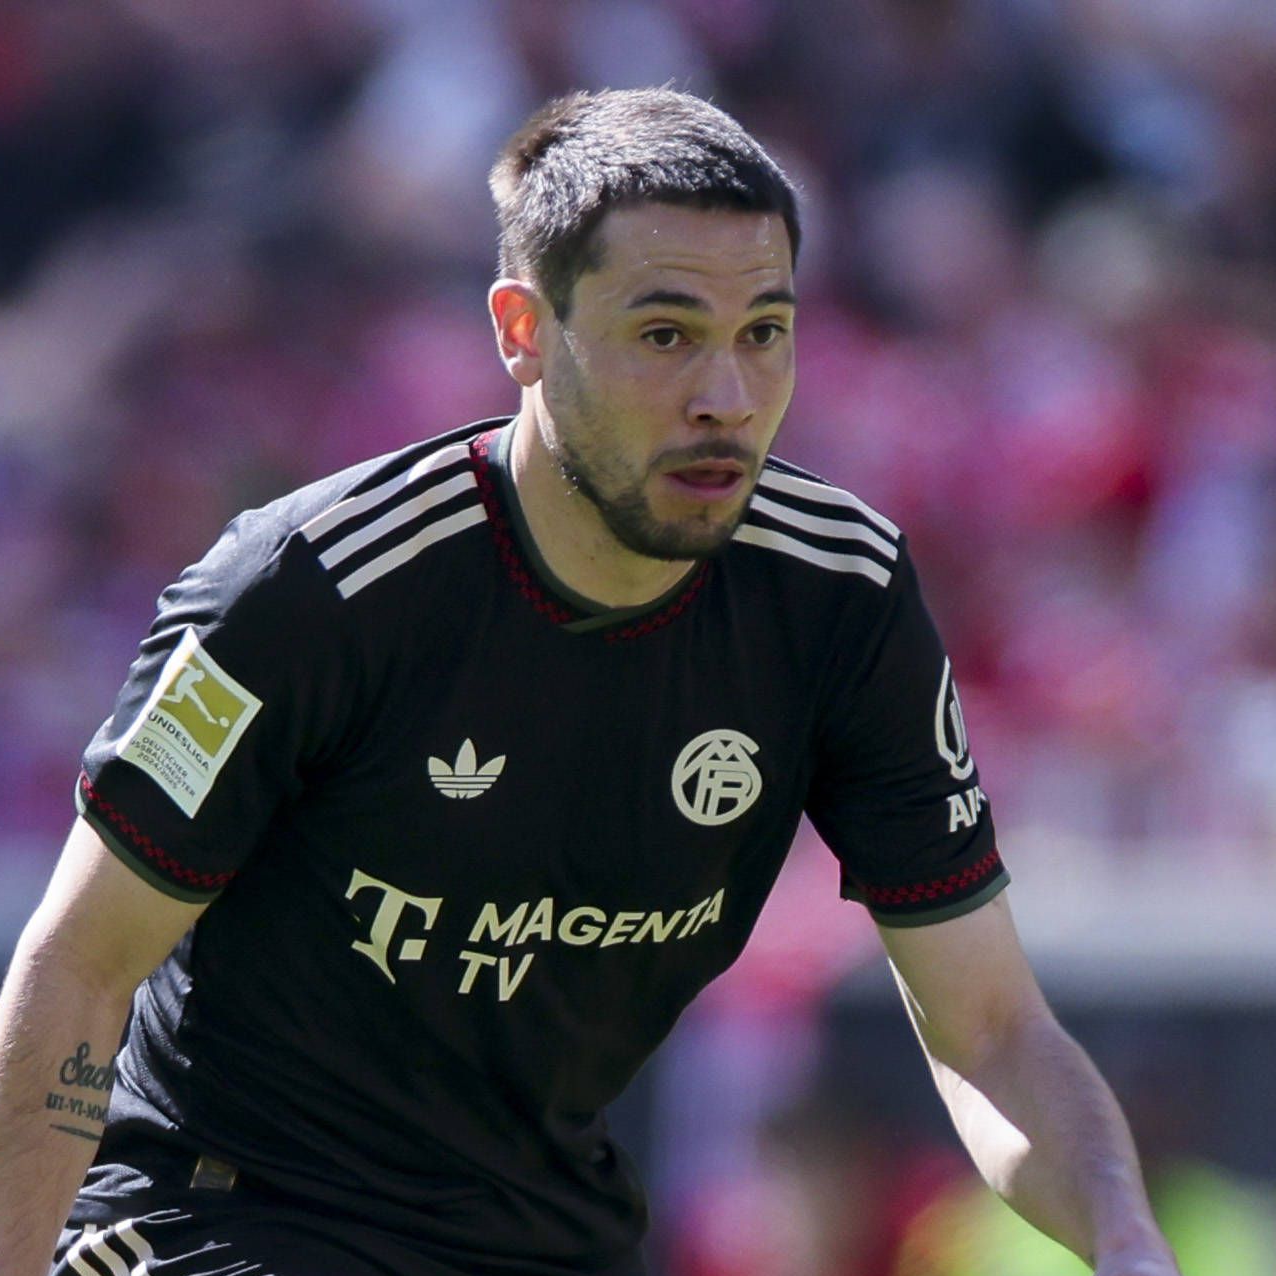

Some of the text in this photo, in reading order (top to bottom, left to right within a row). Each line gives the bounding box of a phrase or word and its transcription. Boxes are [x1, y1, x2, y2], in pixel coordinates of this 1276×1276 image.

[147, 711, 209, 770] UNDESLIGA
[469, 888, 725, 949] MAGENTA
[457, 951, 534, 1001] TV
